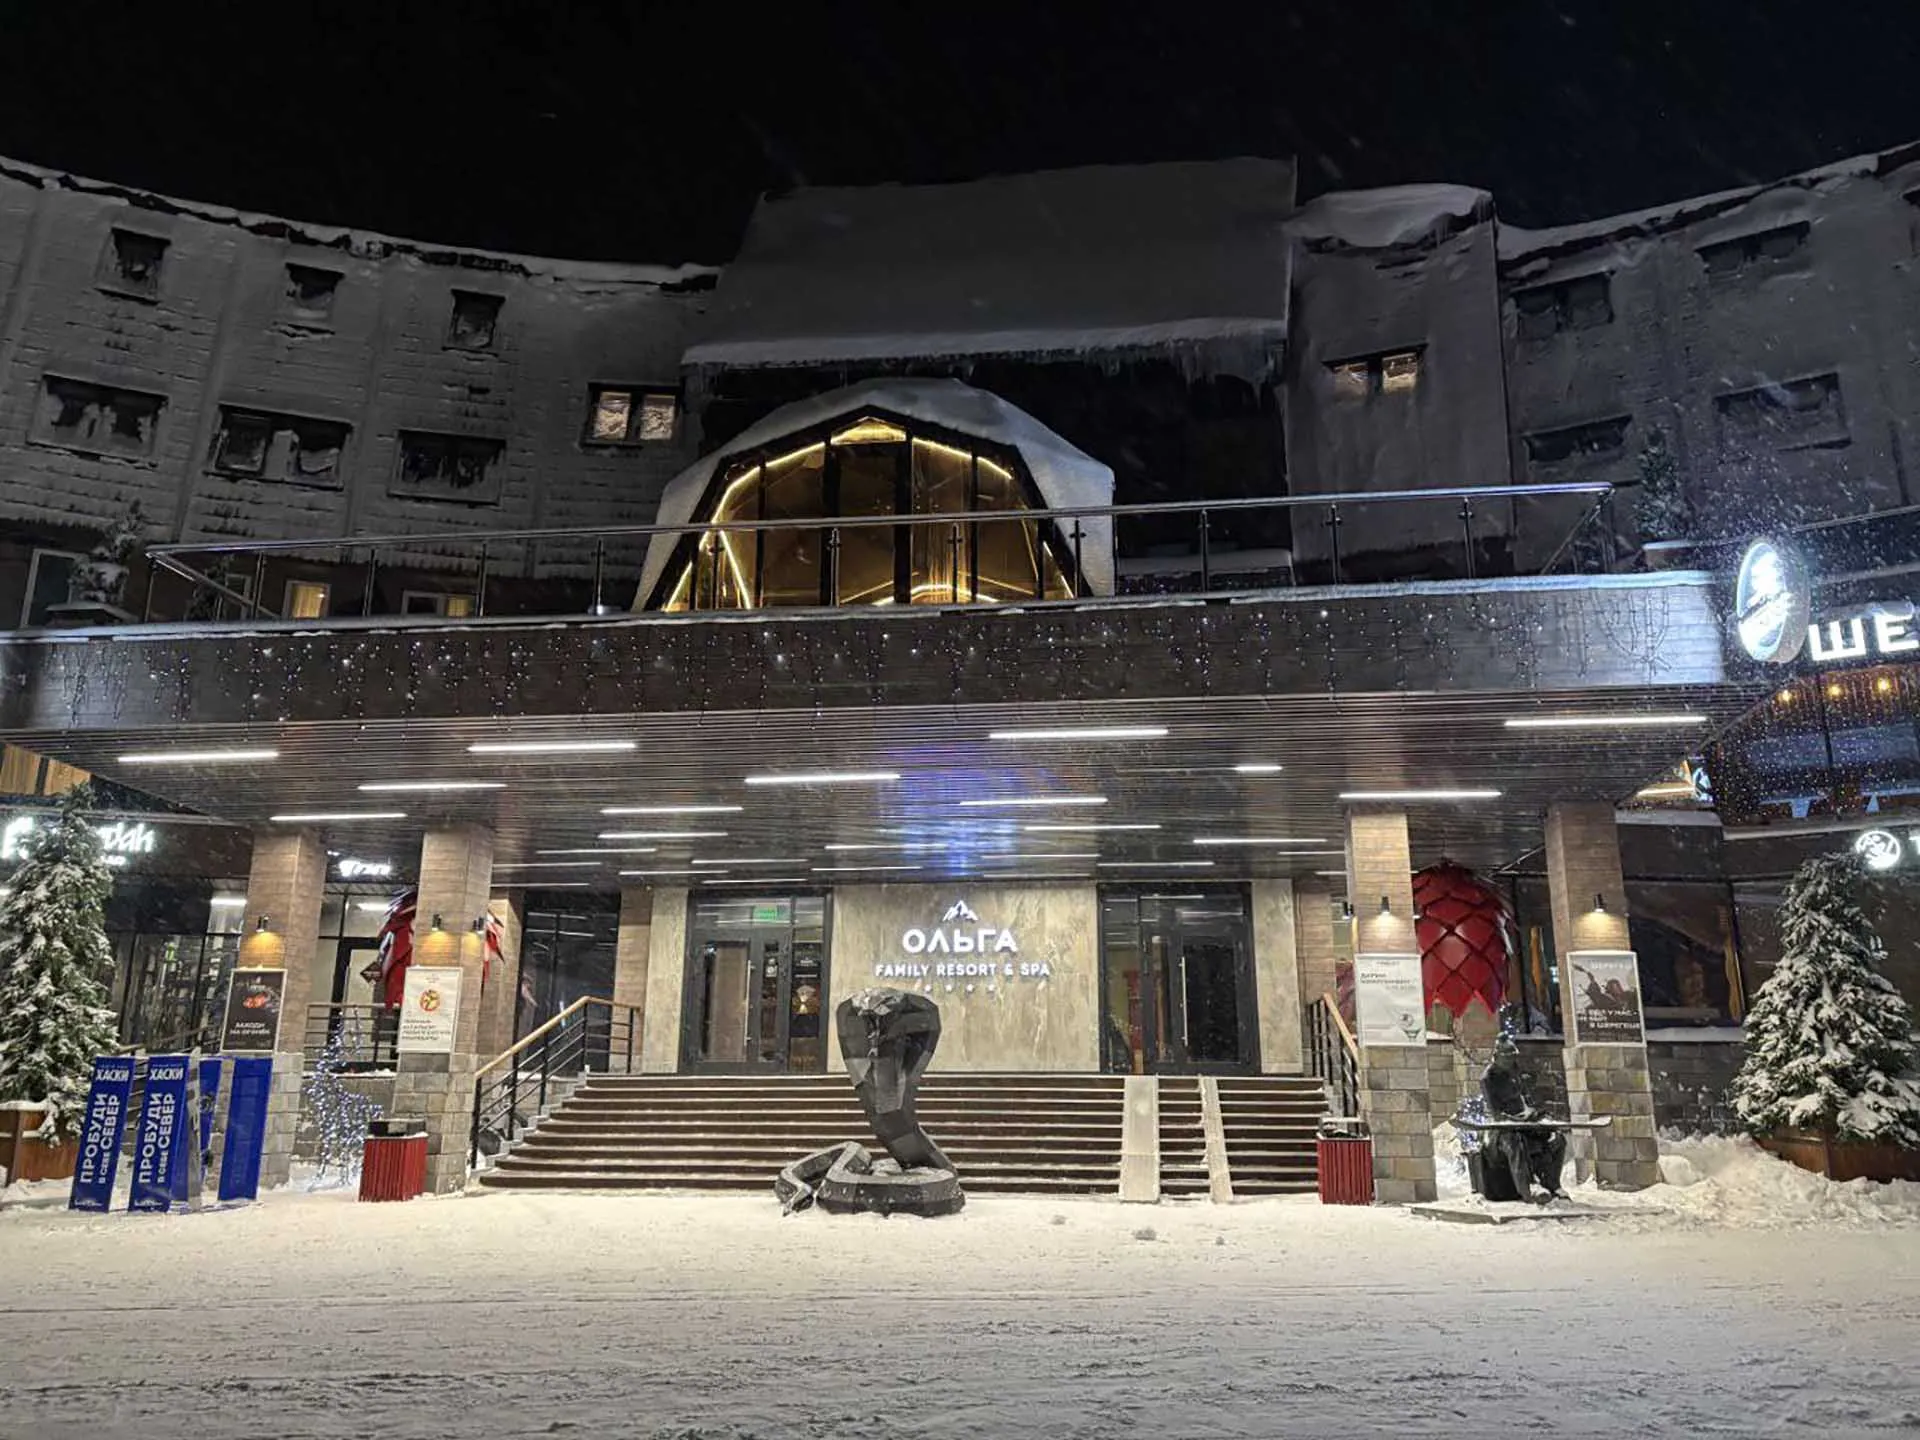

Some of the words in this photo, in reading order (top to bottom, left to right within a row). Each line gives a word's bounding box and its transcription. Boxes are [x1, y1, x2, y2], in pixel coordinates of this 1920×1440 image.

[902, 928, 1018, 953] ОЛЬГА
[875, 963, 929, 977] FAMILY
[936, 963, 996, 976] RESORT
[1003, 962, 1013, 976] &
[1021, 962, 1050, 976] SPA
[95, 1068, 129, 1082] ХАСКИ
[149, 1067, 184, 1081] ХАСКИ
[80, 1093, 109, 1184] ПРОБУДИ
[101, 1095, 120, 1150] СЕВЕР
[138, 1093, 164, 1184] ПРОБУДИ
[157, 1094, 175, 1149] СЕВЕР
